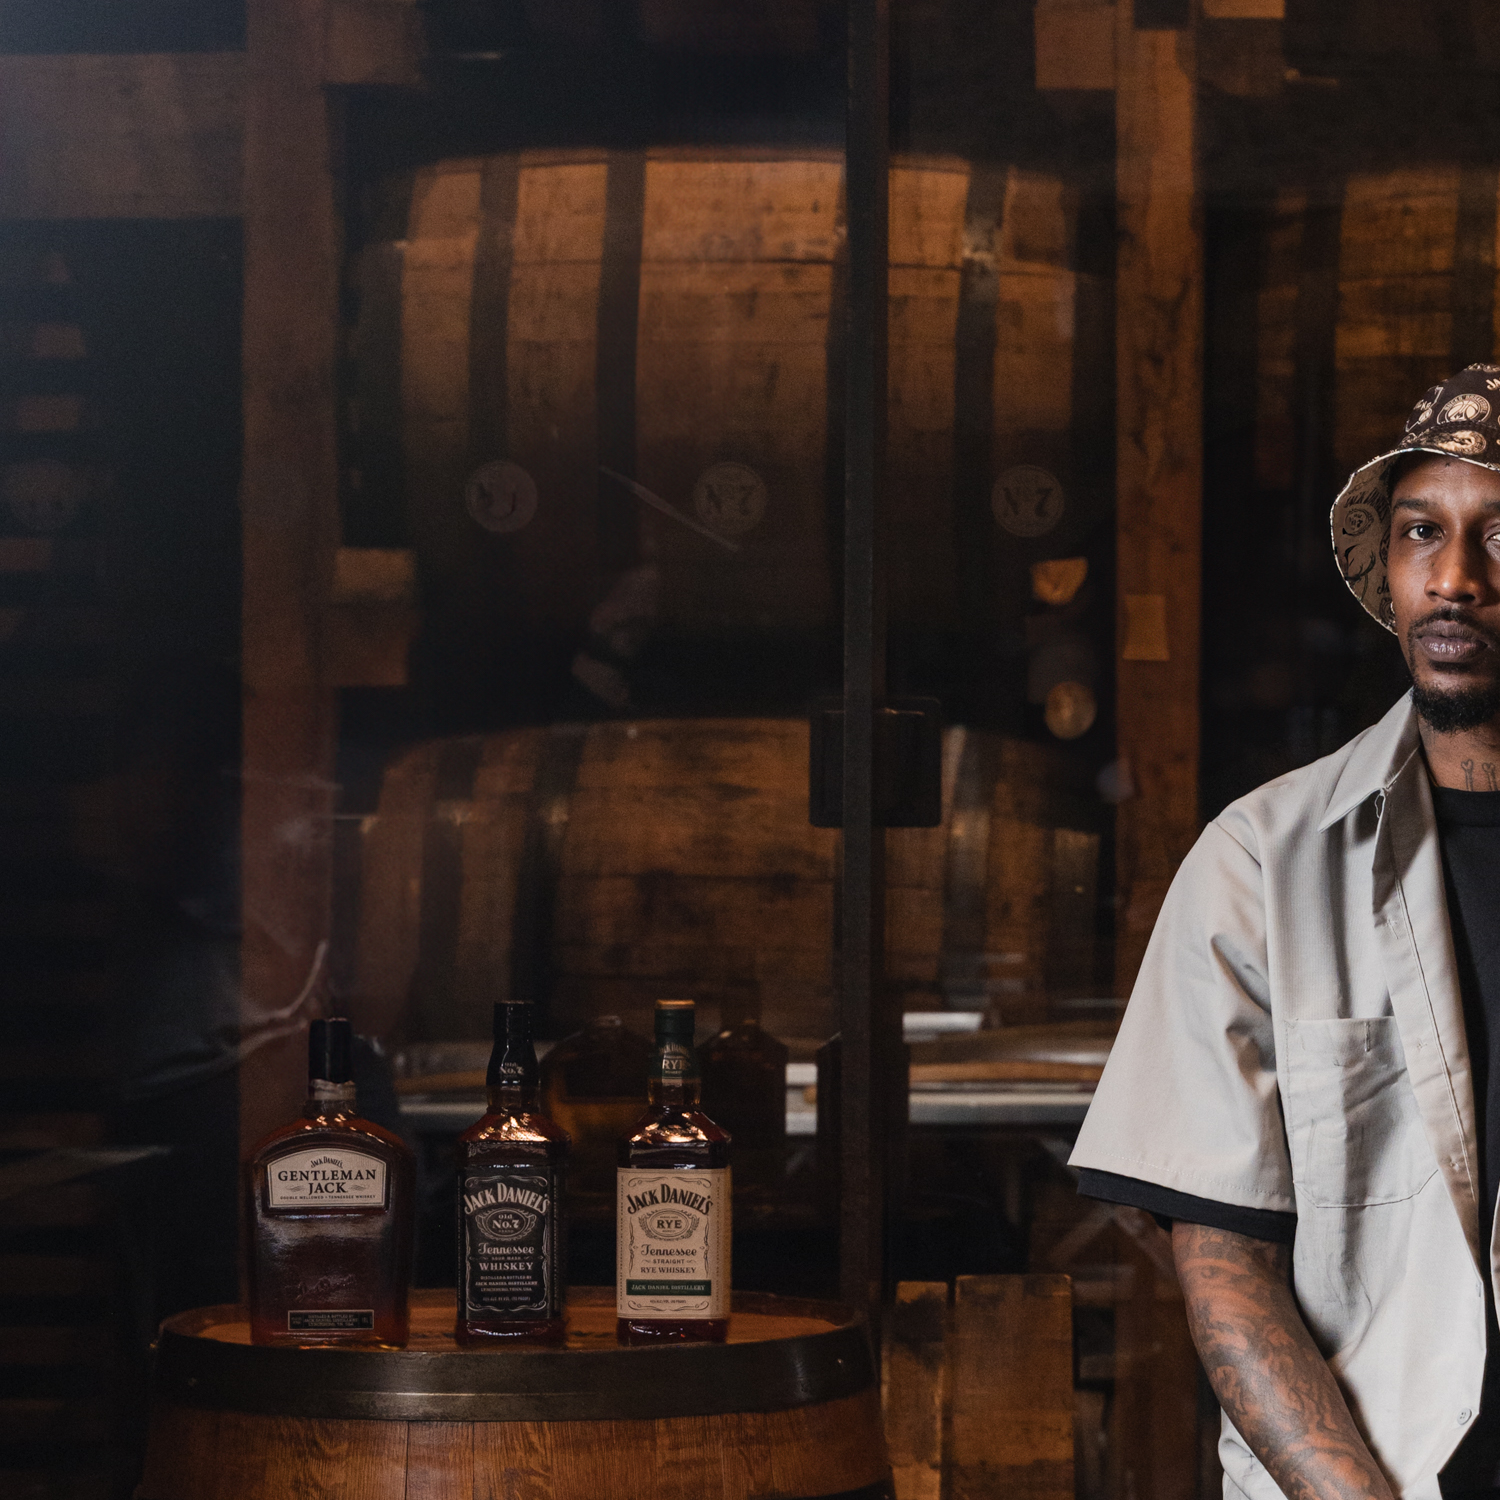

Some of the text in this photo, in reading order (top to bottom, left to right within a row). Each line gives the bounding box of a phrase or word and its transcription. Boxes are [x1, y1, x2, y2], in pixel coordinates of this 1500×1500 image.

[311, 1158, 323, 1169] JACK
[278, 1169, 376, 1181] GENTLEMAN
[308, 1182, 347, 1195] JACK
[463, 1182, 551, 1215] JACK DANIEL'S
[627, 1184, 713, 1215] JACK DANIEL'S
[492, 1219, 519, 1229] No.7
[656, 1220, 682, 1229] RYE
[478, 1242, 534, 1255] Tennessee
[641, 1244, 697, 1256] Tennessee
[479, 1262, 534, 1271] WHISKEY
